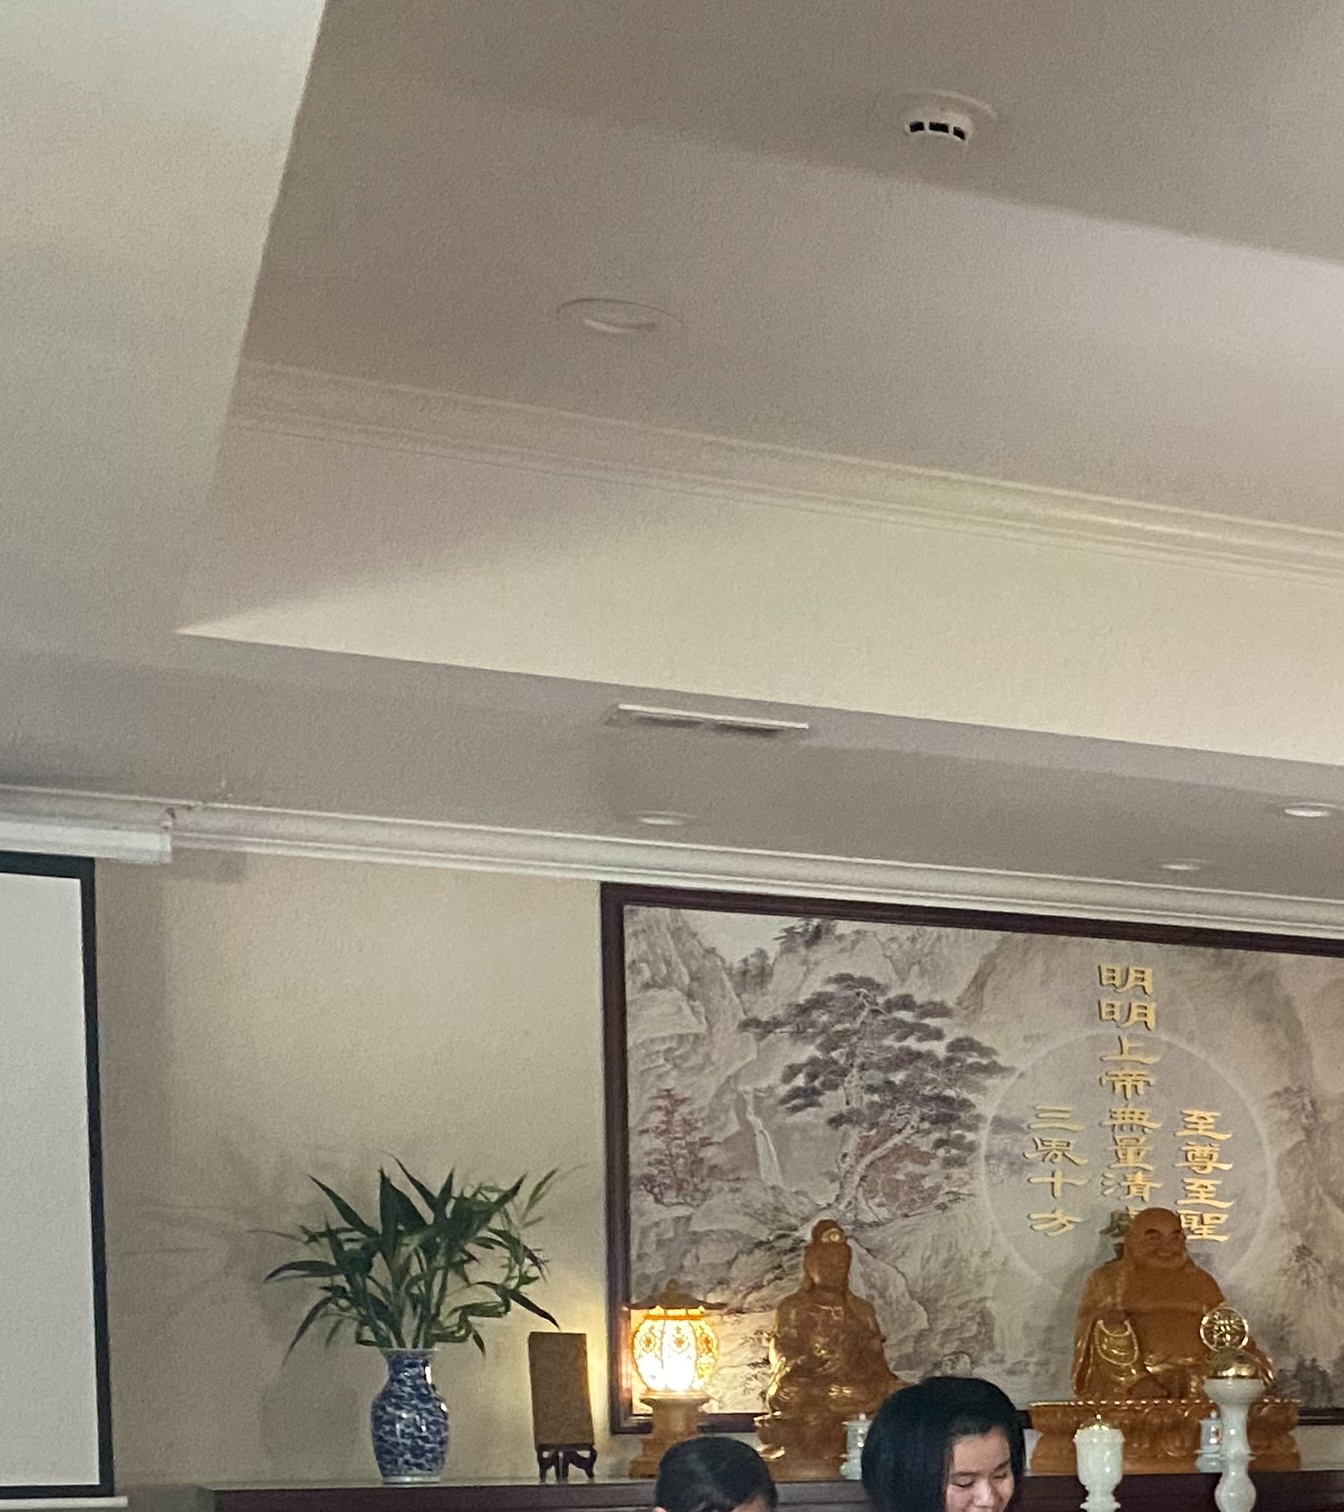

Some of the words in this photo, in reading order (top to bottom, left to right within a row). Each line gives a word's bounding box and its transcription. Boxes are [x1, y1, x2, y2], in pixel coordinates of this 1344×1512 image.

[1023, 1104, 1089, 1237] 三界十方
[1174, 1109, 1234, 1242] 至尊至聖
